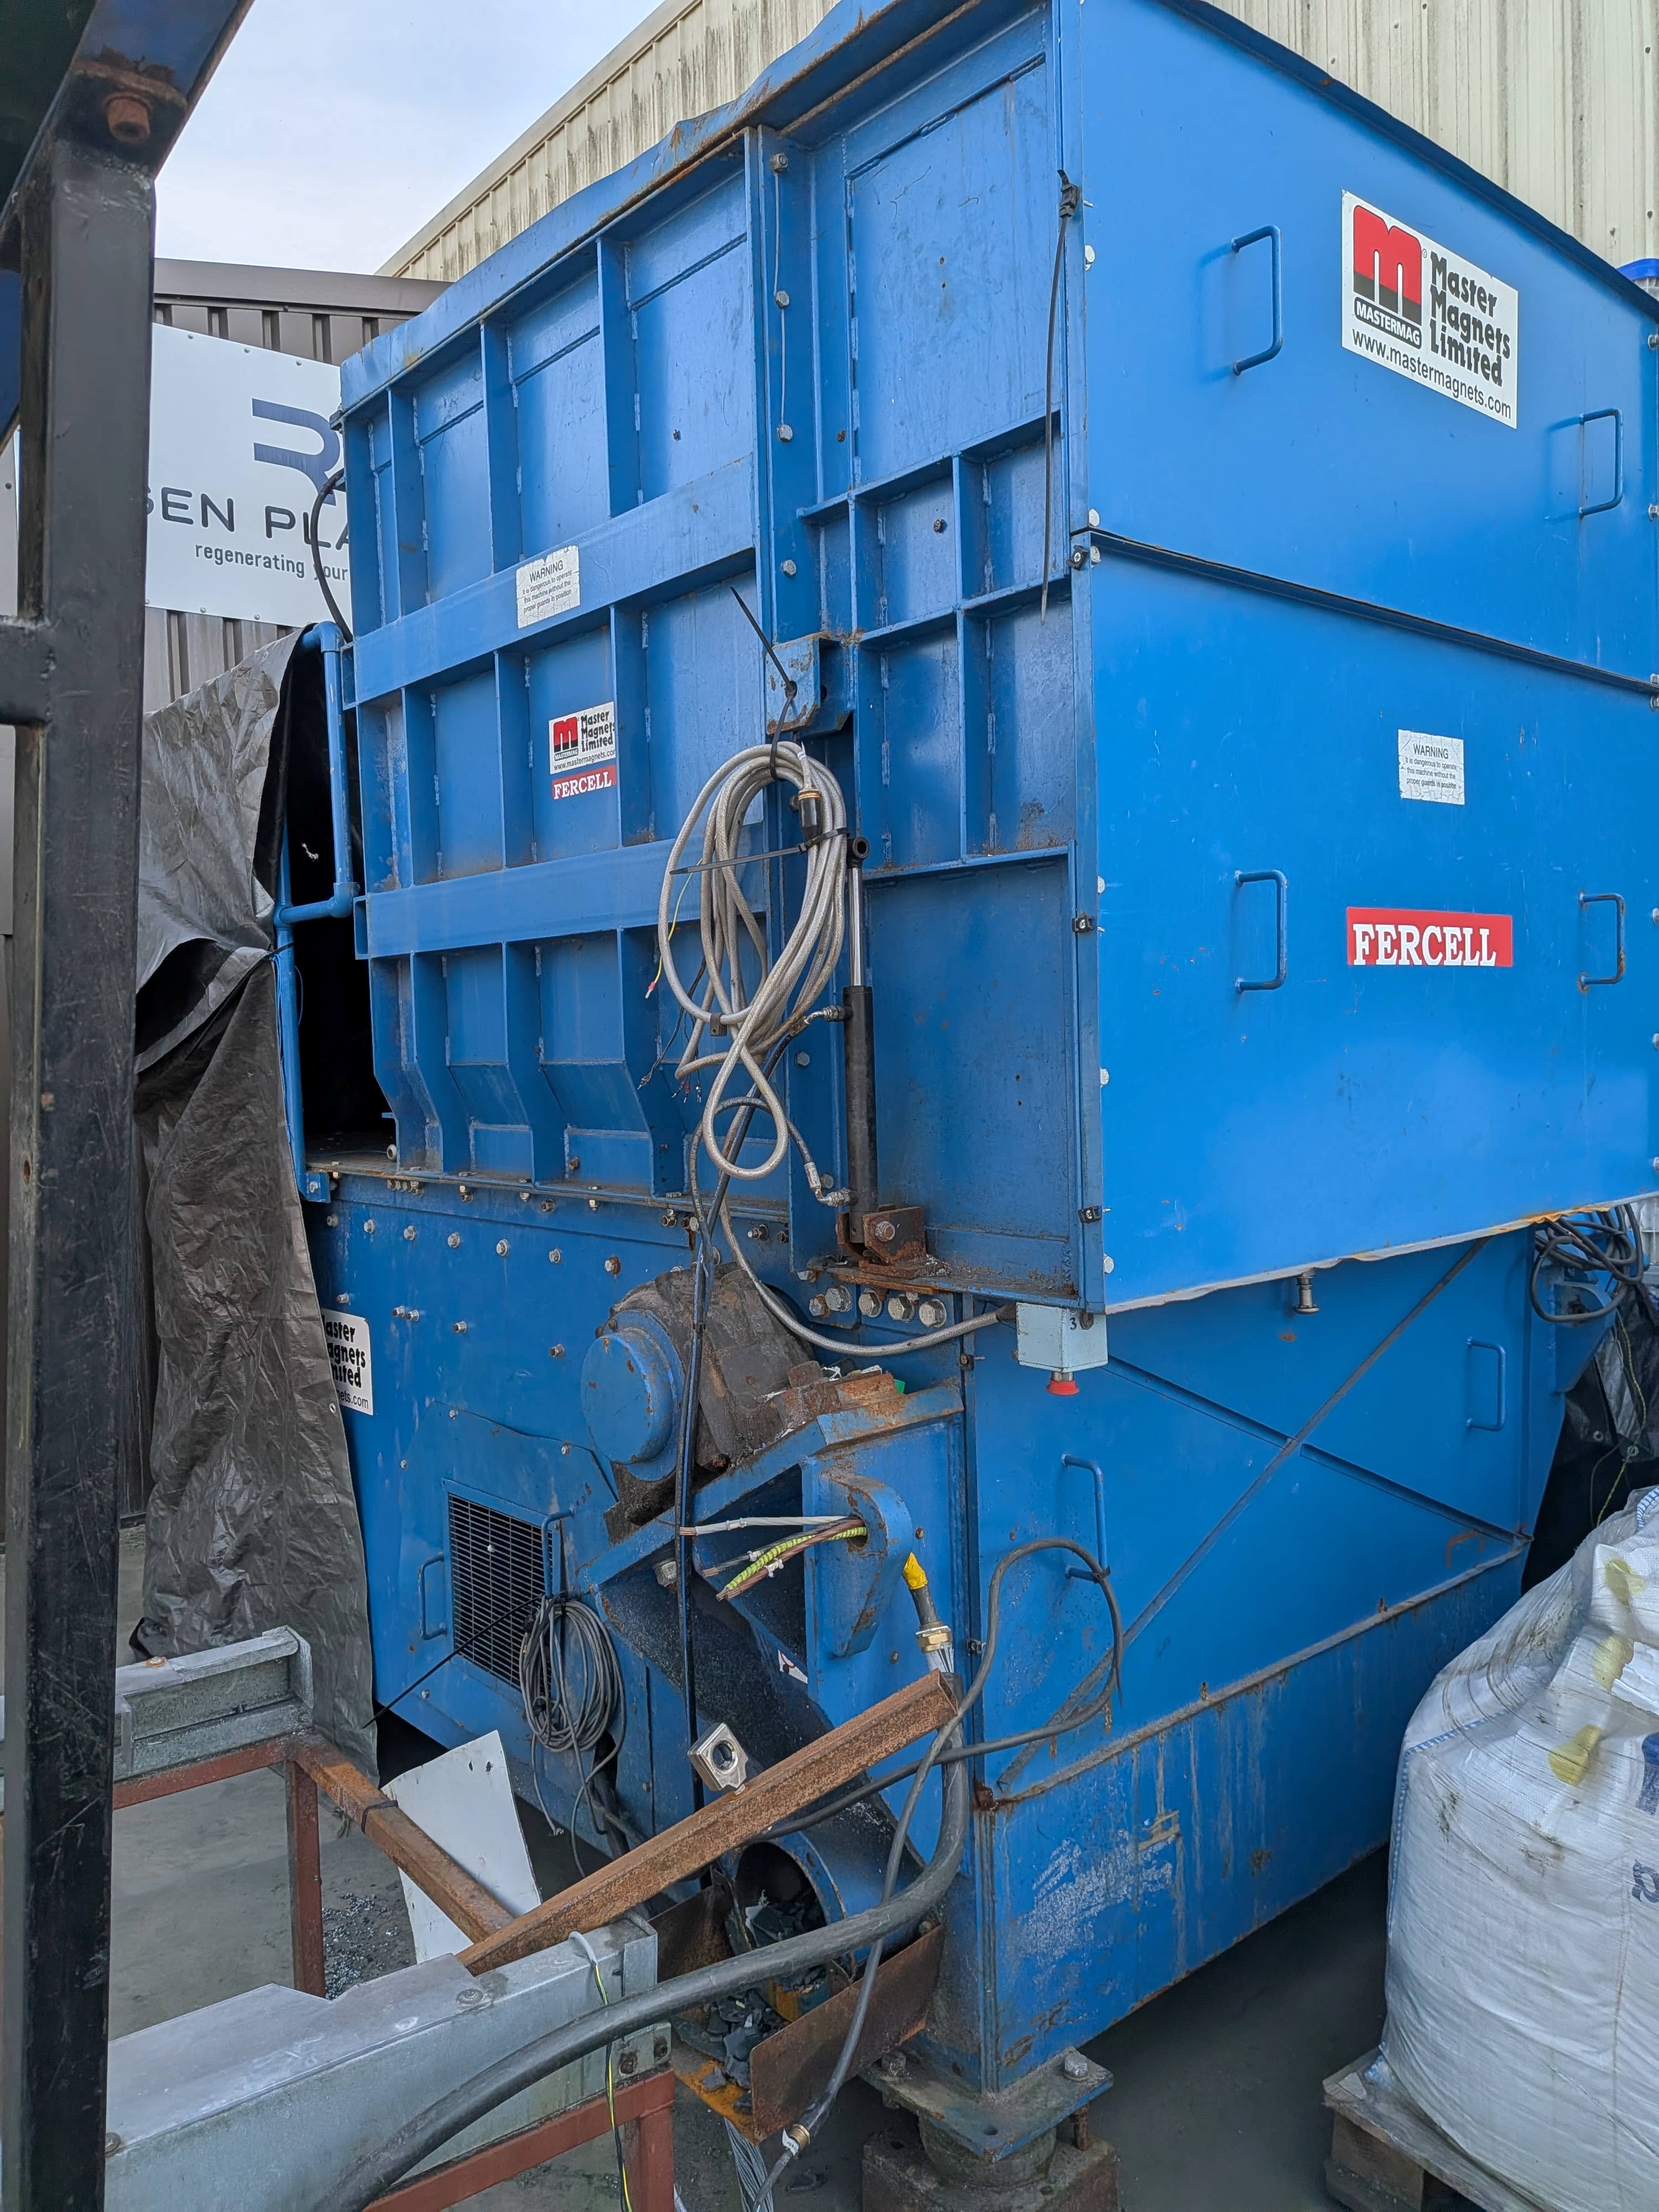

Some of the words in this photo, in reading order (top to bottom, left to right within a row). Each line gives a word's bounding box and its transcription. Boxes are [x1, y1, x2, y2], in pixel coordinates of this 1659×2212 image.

[1430, 251, 1497, 317] Master
[1357, 302, 1420, 346] MASTERMAG
[1430, 284, 1510, 359] Magnets
[1430, 319, 1503, 387] Limited
[1352, 328, 1511, 420] www.mastermagnets.com
[196, 544, 305, 578] regenerating
[529, 560, 564, 582] WARNING
[530, 579, 551, 592] dangerous
[556, 570, 572, 581] operate
[531, 589, 548, 600] machine
[548, 582, 564, 594] without
[523, 603, 536, 614] proper
[536, 598, 550, 609] guards
[556, 589, 572, 601] position
[581, 711, 610, 728] Master
[581, 732, 613, 753] Limited
[1413, 743, 1449, 759] WARNING
[1413, 758, 1436, 768] dangerous
[1416, 768, 1433, 776] machine
[554, 771, 612, 800] FERCELL
[1353, 924, 1496, 967] FERCELL
[1070, 1317, 1077, 1331] 3
[327, 1343, 366, 1368] agnets
